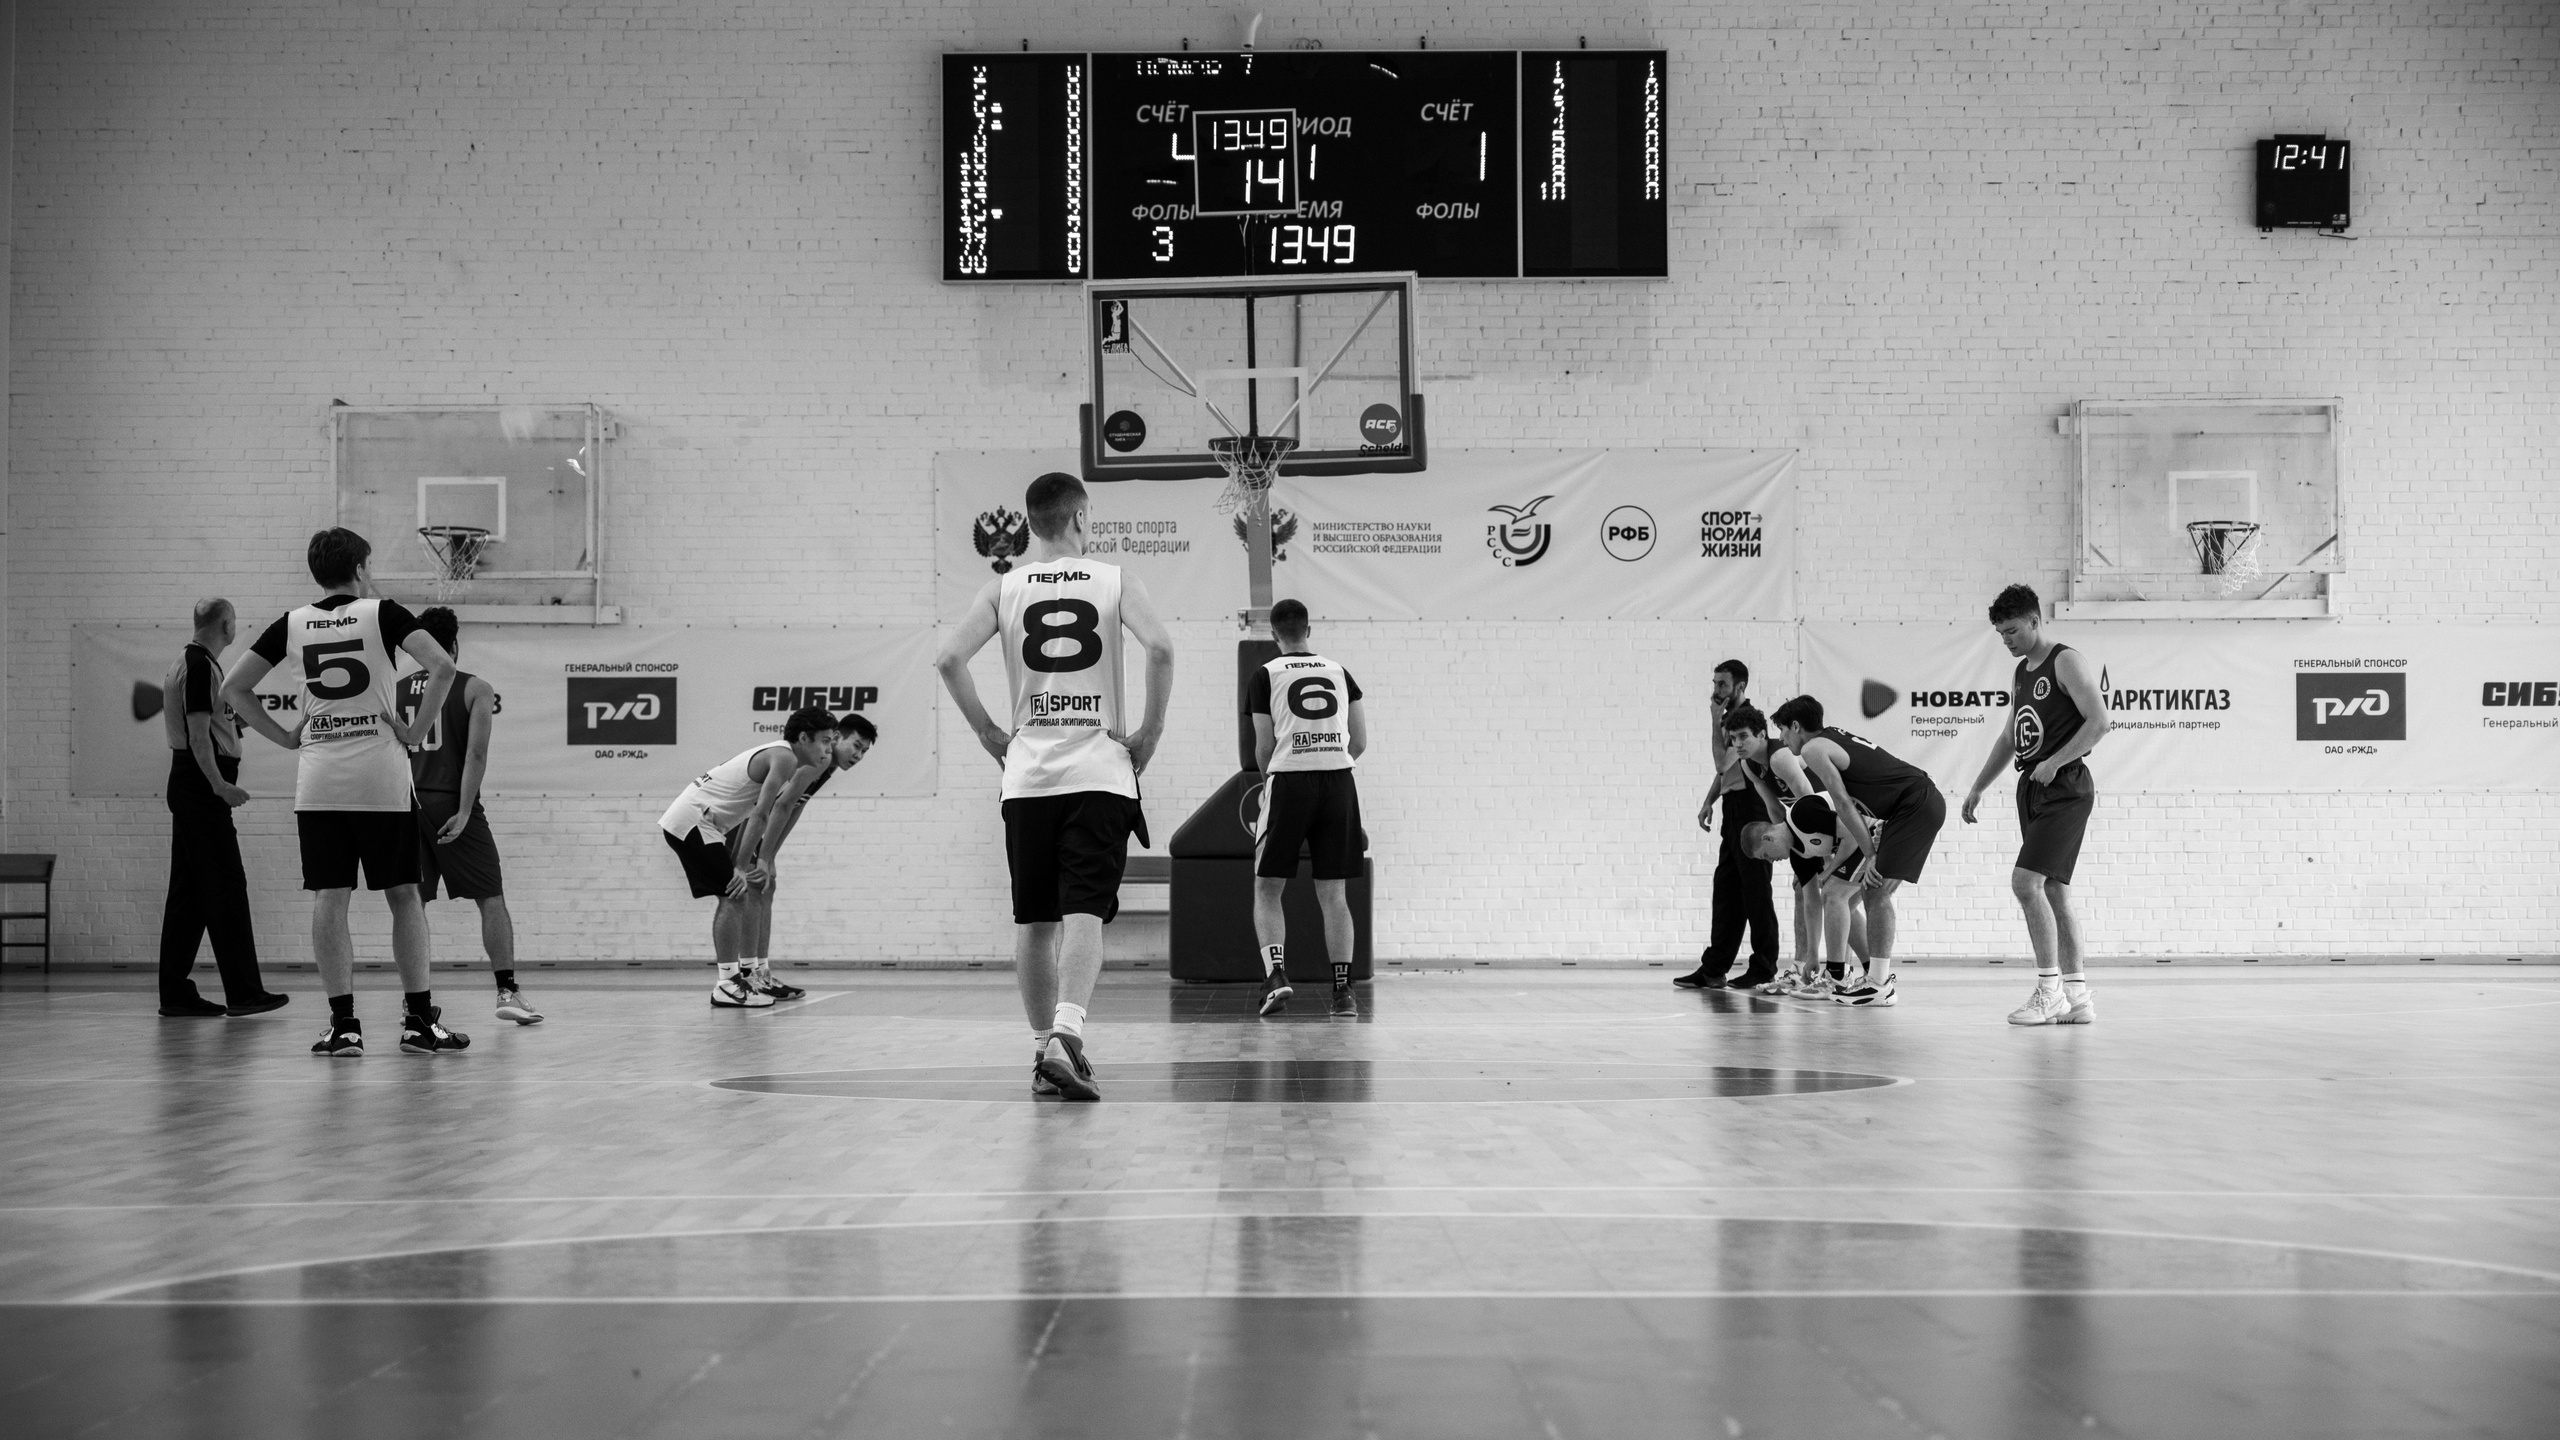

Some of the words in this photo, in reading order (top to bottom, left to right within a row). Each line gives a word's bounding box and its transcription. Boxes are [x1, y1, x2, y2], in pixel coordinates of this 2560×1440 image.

[1136, 100, 1189, 123] СЧЁТ
[1420, 99, 1473, 122] СЧЁТ
[1297, 116, 1352, 138] ИОД
[1479, 131, 1486, 181] 1
[2274, 144, 2346, 171] 12:41
[1245, 158, 1284, 204] 14
[1132, 203, 1195, 222] ФОЛЫ
[1416, 201, 1480, 220] ФОЛЫ
[1152, 226, 1174, 262] 3
[1313, 522, 1394, 531] МИНИСТЕРСТВО
[1396, 522, 1431, 531] НАУКИ
[1701, 511, 1751, 526] СПОРТ
[1136, 521, 1177, 537] спорта
[1608, 525, 1650, 541] РФБ
[1701, 527, 1761, 542] НОРМА
[1121, 537, 1190, 556] Федерации
[1313, 534, 1320, 542] И
[1323, 534, 1371, 542] ВЫСШЕГО
[1372, 534, 1442, 543] ОБРАЗОВАНИЯ
[1313, 544, 1380, 553] РОССИЙСКОЙ
[1382, 545, 1441, 554] ФЕДЕРАЦИИ
[1701, 543, 1761, 557] ЖИЗНИ
[1027, 571, 1091, 584] ПЕРМЬ
[306, 616, 358, 629] ПЕРМЬ
[1022, 598, 1103, 673] 8
[302, 638, 371, 700] 5
[565, 663, 632, 672] ГЕНЕРАЛЬНЫЙ
[635, 664, 679, 672] СПОНСОР
[1285, 662, 1326, 670] ПЕРМЬ
[2294, 658, 2361, 668] ГЕНЕРАЛЬНЫЙ
[2364, 659, 2408, 668] СПОНСОР
[752, 686, 879, 711] СИБУР
[1287, 676, 1338, 720] 6
[1911, 690, 2014, 707] НОВАТЭ
[2111, 689, 2231, 711] АРКТИКГАЗ
[2482, 682, 2560, 706] СИБ
[1050, 695, 1101, 712] SPORT
[333, 714, 377, 727] SPORT
[1911, 714, 1985, 726] Генеральный
[2179, 721, 2221, 731] партнер
[2483, 717, 2559, 730] Генеральный
[1294, 734, 1308, 745] RA
[1311, 733, 1342, 743] SPORT
[1911, 729, 1958, 739] партнер
[2020, 721, 2032, 747] 15
[2325, 746, 2343, 754] ОАО
